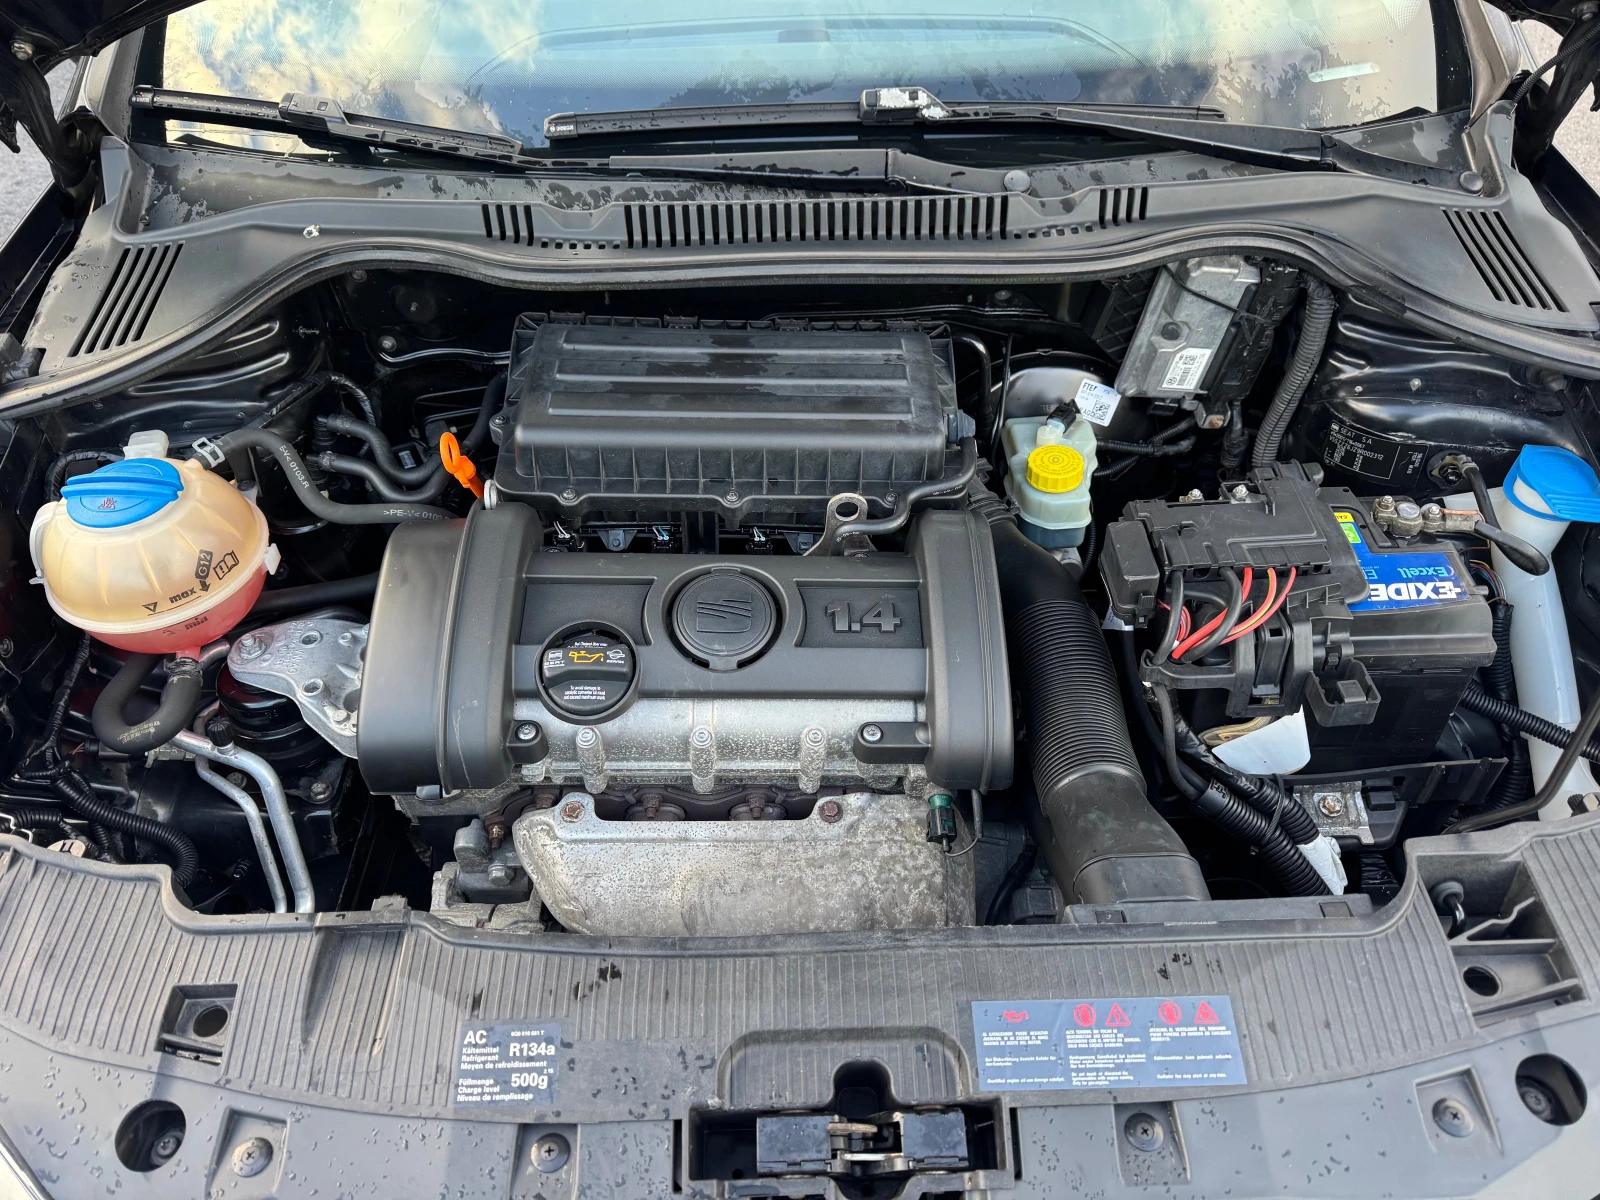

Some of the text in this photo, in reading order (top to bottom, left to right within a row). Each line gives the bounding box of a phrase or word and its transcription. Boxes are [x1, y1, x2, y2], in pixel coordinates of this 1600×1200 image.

[1341, 428, 1356, 438] SEAT
[198, 552, 211, 576] G12
[1397, 567, 1449, 578] Excell
[169, 587, 197, 603] max
[1370, 582, 1461, 601] EXIDE
[825, 600, 902, 633] 1.4
[464, 1030, 487, 1044] AC
[509, 1042, 555, 1056] R134a
[511, 1073, 548, 1089] 500g
[493, 1093, 533, 1101] remplissage
